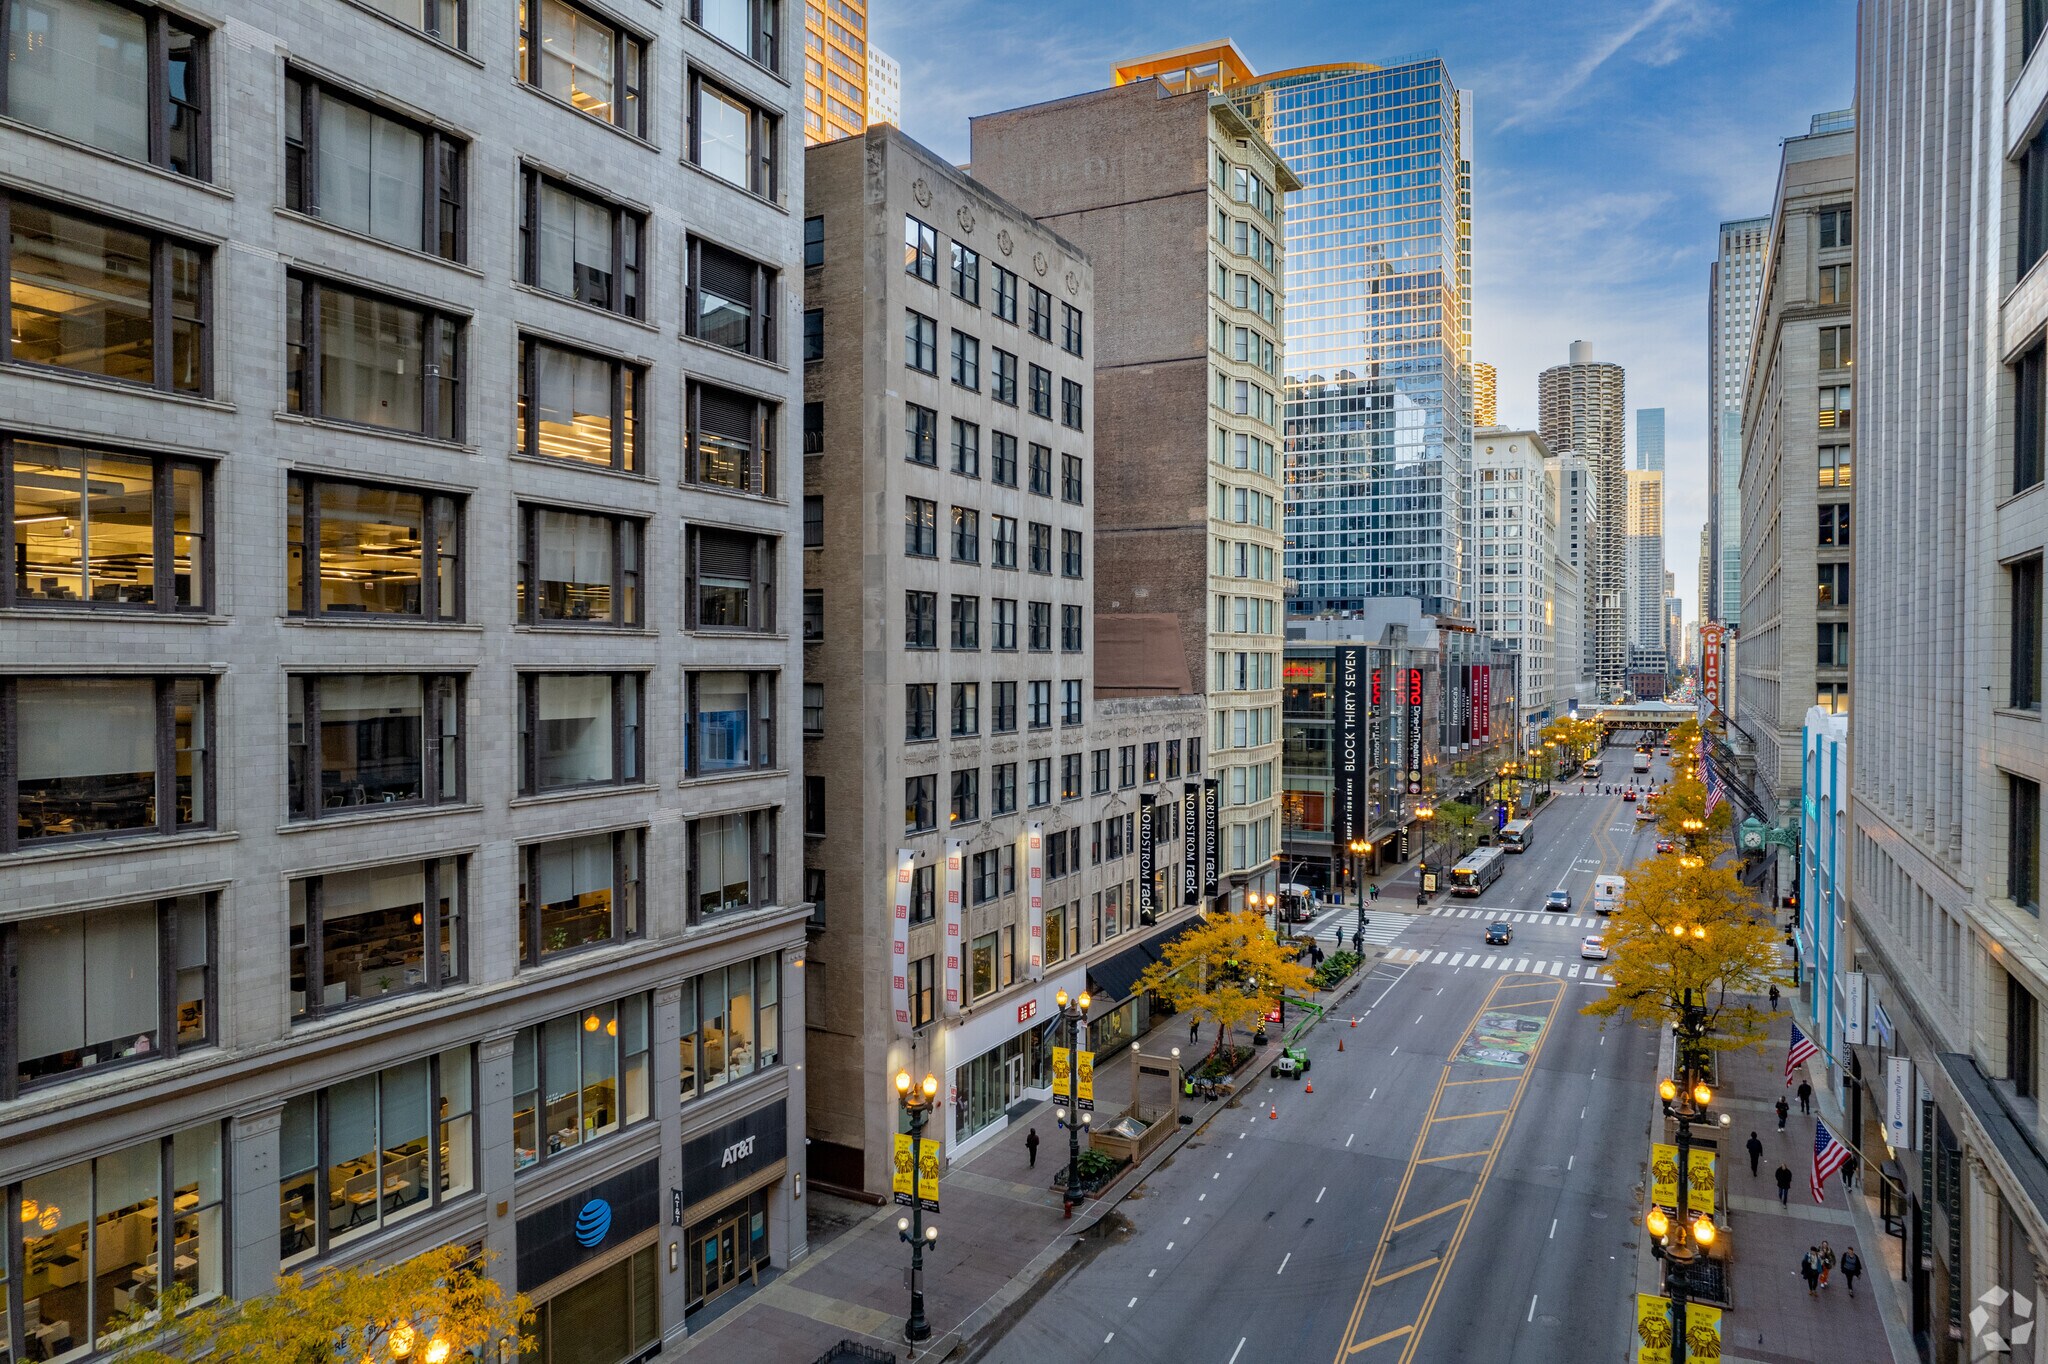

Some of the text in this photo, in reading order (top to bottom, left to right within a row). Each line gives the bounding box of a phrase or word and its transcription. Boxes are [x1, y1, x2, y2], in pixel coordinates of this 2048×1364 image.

[1283, 667, 1314, 677] amc
[1410, 669, 1421, 705] amc
[1706, 633, 1717, 701] CHICAG
[1344, 650, 1356, 772] BLOCK THIRTY SEVEN
[1450, 686, 1459, 726] francesca's
[1205, 788, 1217, 886] NORDSTROM rack
[1346, 813, 1353, 821] AT
[1142, 805, 1154, 915] NORDSTROM rack
[1186, 793, 1198, 895] NORDSTROM rack
[1850, 986, 1858, 1023] CommunityTax
[1893, 1075, 1904, 1120] CommunityTax
[721, 1135, 756, 1168] AT&T
